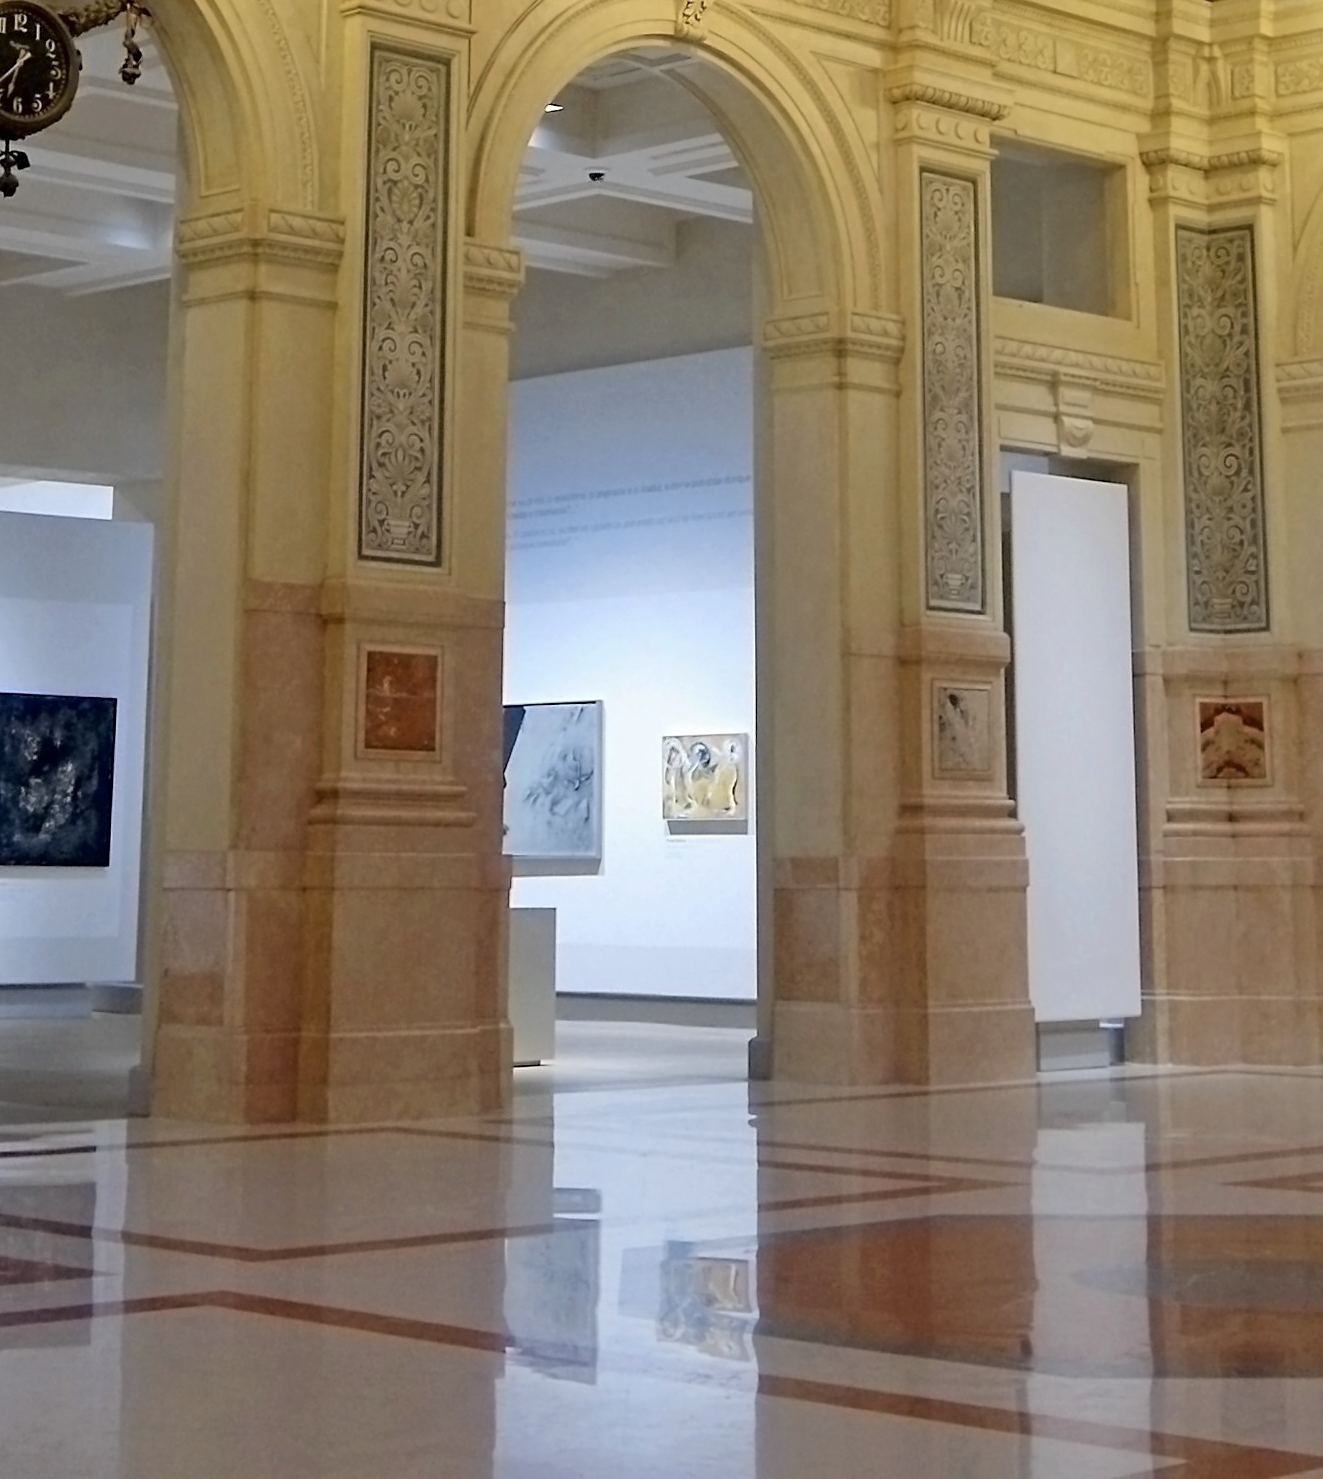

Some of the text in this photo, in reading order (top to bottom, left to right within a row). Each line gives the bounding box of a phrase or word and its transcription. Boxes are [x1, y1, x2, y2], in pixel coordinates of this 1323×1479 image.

[14, 13, 28, 33] 12
[34, 23, 41, 41] 1
[45, 38, 56, 59] 2
[50, 61, 62, 80] 3
[12, 96, 23, 113] 6
[31, 93, 42, 113] 5
